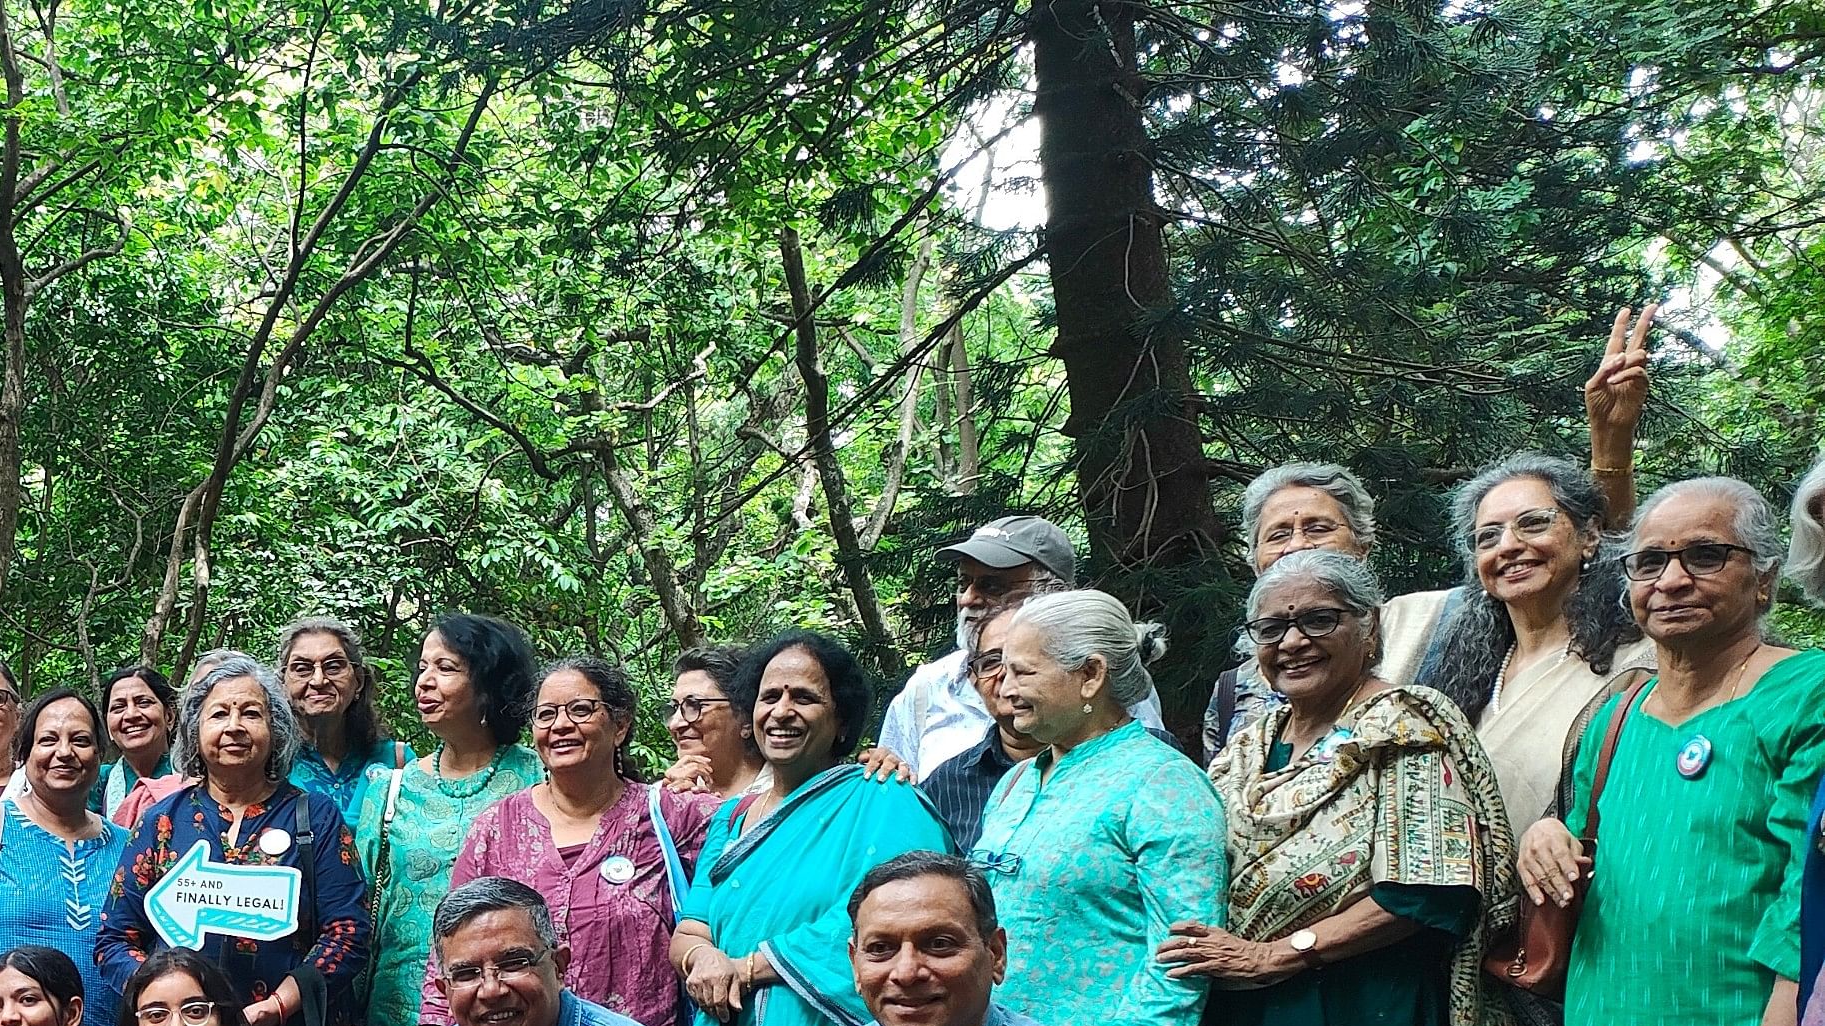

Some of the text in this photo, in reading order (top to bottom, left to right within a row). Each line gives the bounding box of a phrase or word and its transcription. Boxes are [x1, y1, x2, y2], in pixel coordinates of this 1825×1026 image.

[177, 878, 223, 889] 55+ AND
[176, 892, 284, 910] FINALLY LEGAL!
